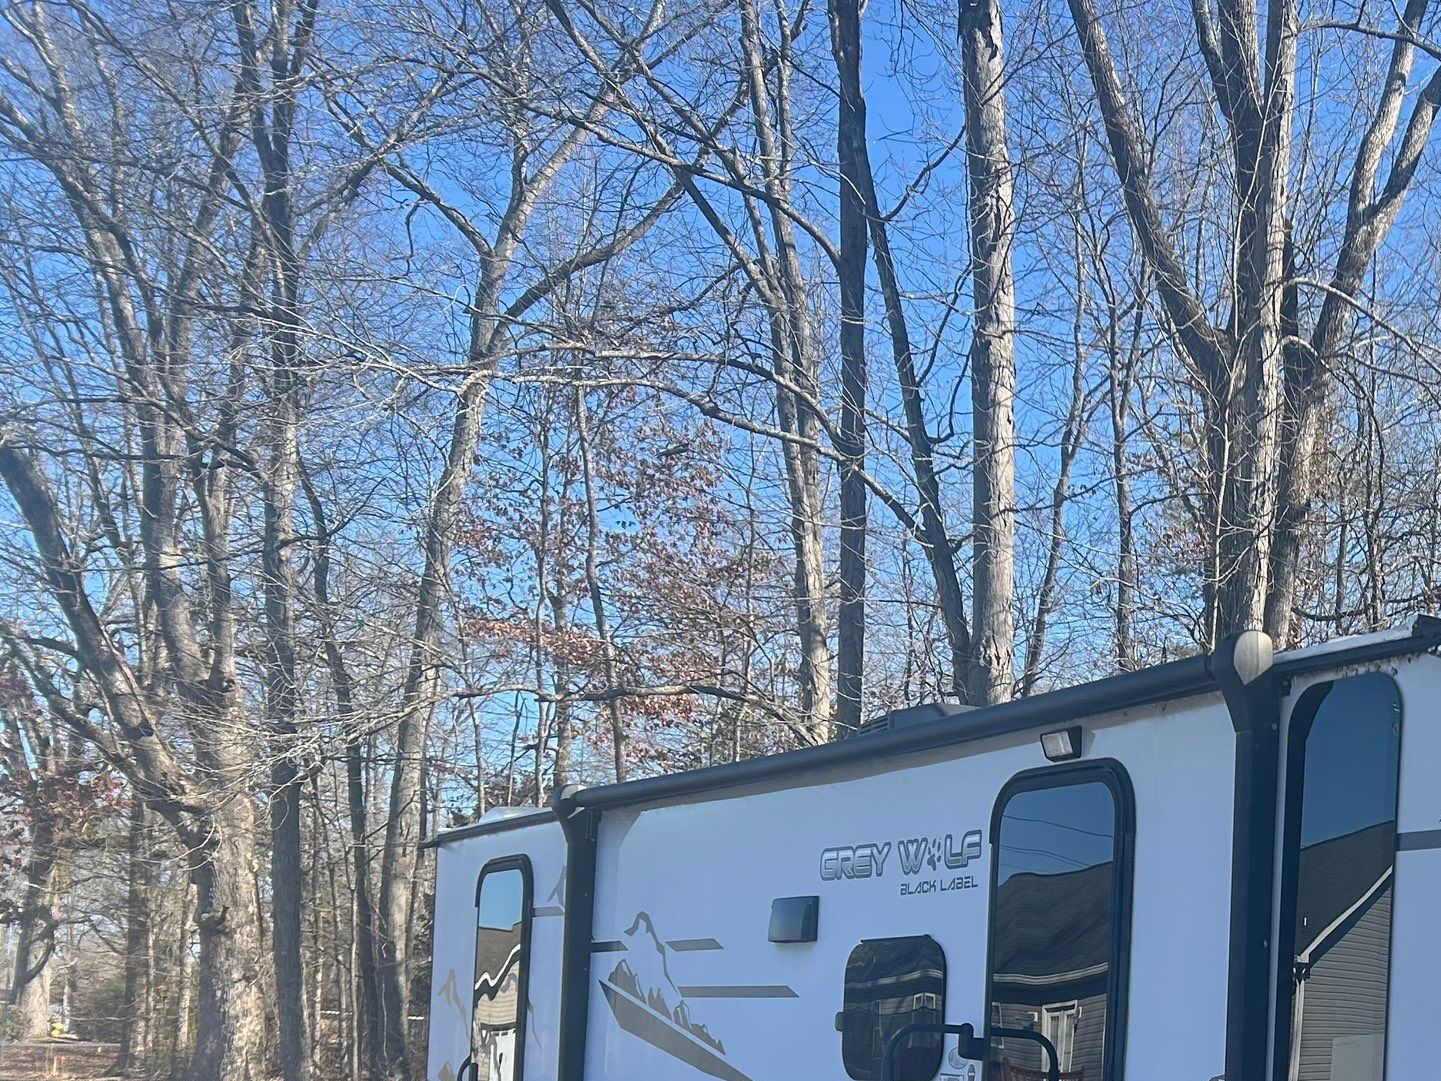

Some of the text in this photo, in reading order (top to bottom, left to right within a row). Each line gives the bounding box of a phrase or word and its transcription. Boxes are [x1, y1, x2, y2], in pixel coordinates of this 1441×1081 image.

[820, 842, 892, 881] GREY
[900, 875, 978, 895] BLACK LABEL
